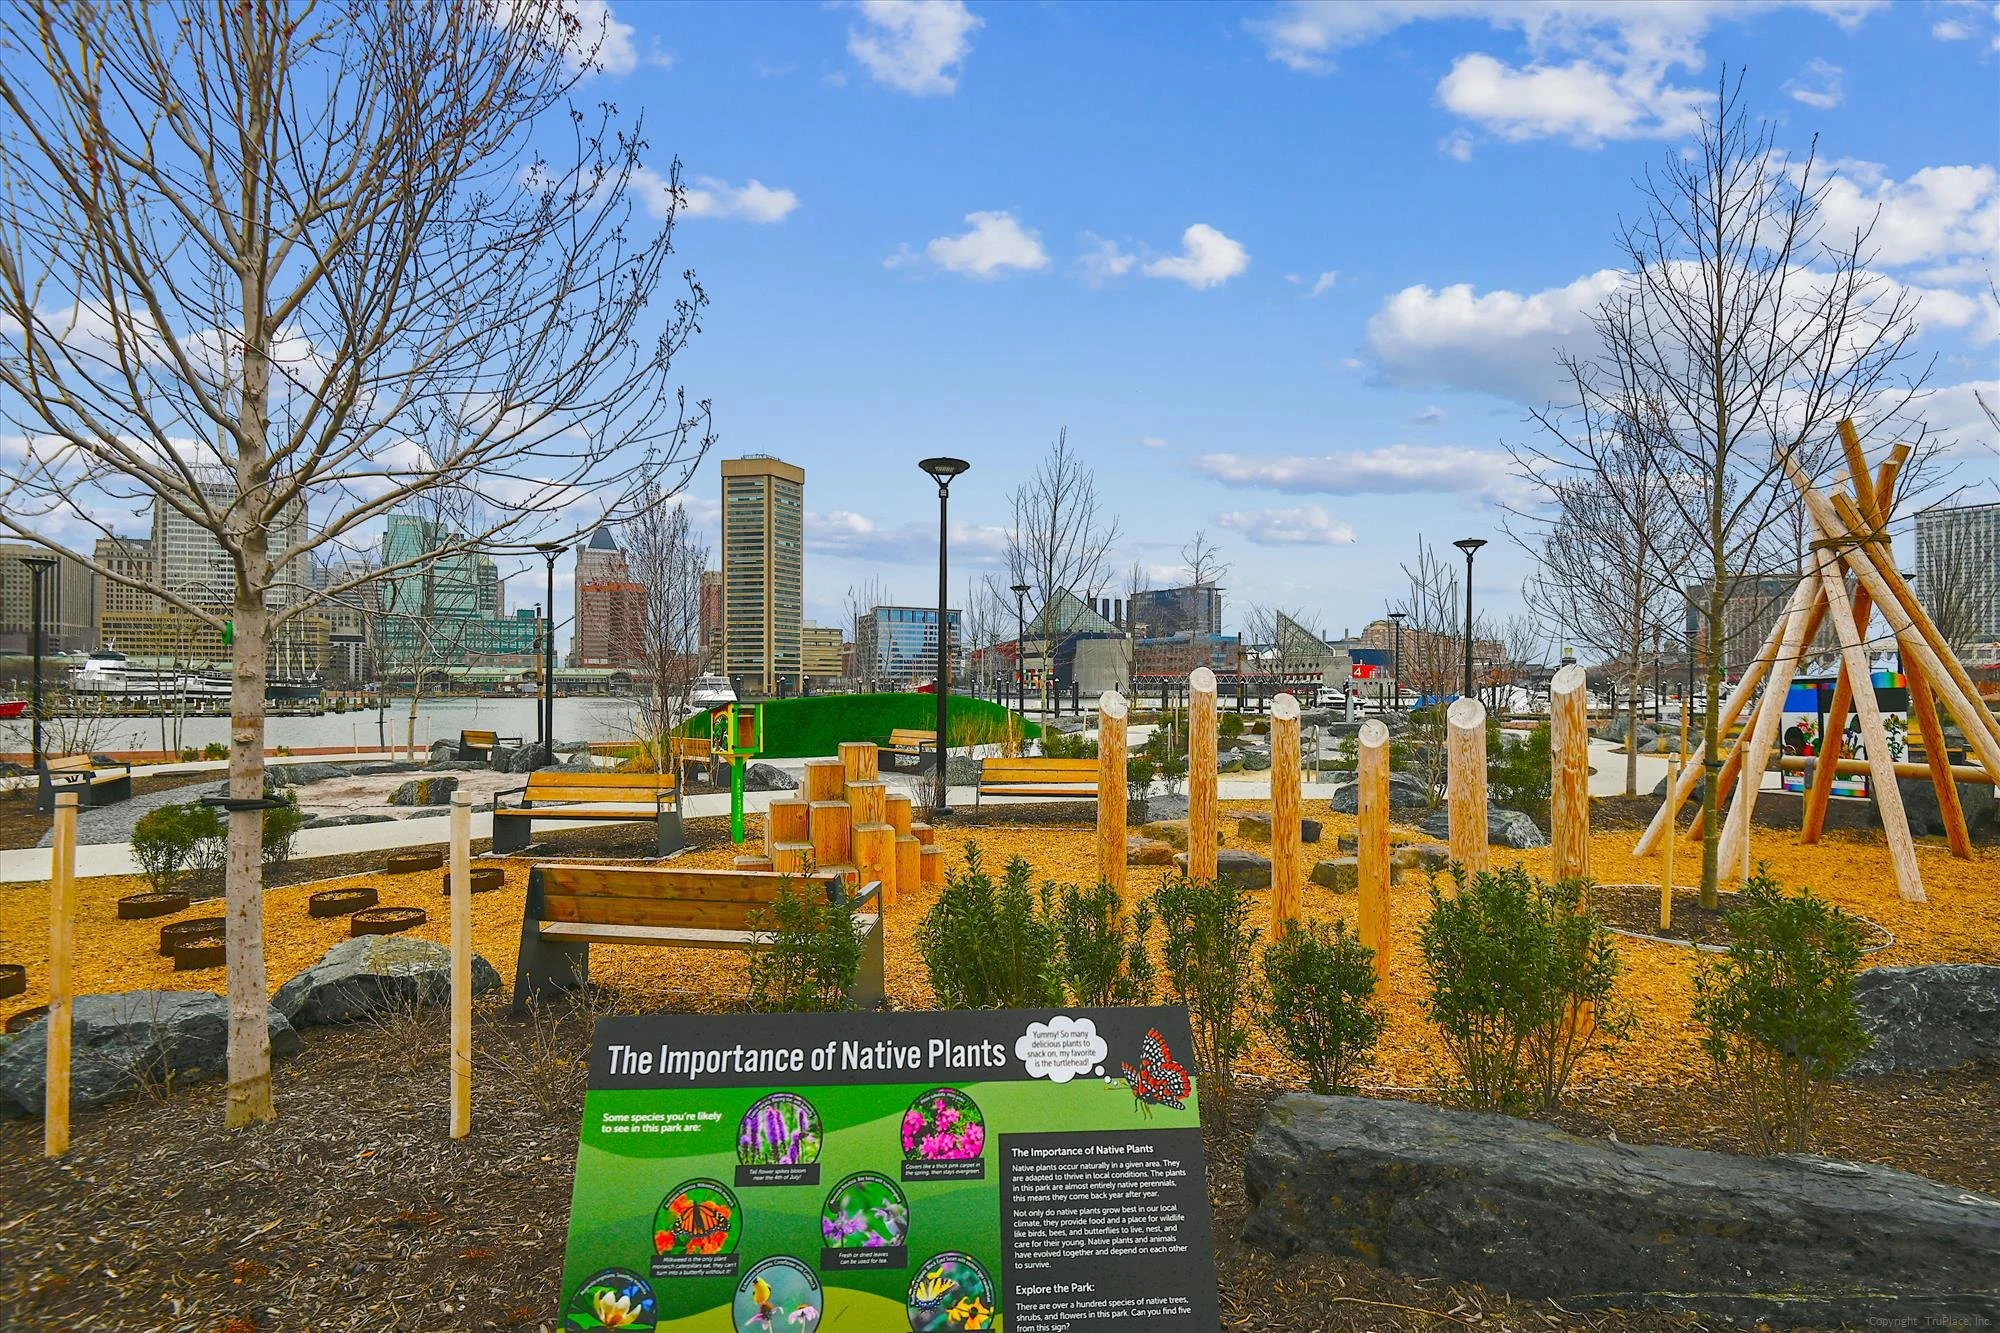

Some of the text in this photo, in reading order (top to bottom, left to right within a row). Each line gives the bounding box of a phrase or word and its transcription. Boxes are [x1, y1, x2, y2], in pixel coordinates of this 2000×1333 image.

[1033, 1030, 1088, 1041] Yummy! So many
[1032, 1039, 1061, 1048] delicious
[1062, 1040, 1082, 1049] plants
[608, 1038, 1006, 1080] The Importance of Native Plants
[1027, 1050, 1045, 1058] snack
[1060, 1051, 1070, 1059] my
[1071, 1049, 1096, 1057] favorite
[1035, 1059, 1040, 1067] is
[1054, 1058, 1089, 1067] turtlehead!
[603, 1112, 722, 1123] Some species you're likely
[602, 1125, 612, 1133] to
[631, 1124, 640, 1132] in
[642, 1124, 659, 1132] this
[661, 1123, 682, 1134] park
[1011, 1144, 1154, 1158] The Importance of Native Plants
[1012, 1164, 1034, 1172] Native
[1036, 1164, 1057, 1172] plants
[1080, 1162, 1110, 1171] naturally
[1125, 1161, 1144, 1170] given
[1163, 1159, 1180, 1168] They
[1025, 1174, 1053, 1183] adapted
[1111, 1170, 1149, 1178] conditions.
[1165, 1169, 1186, 1178] plants
[1021, 1184, 1034, 1192] this
[1035, 1184, 1051, 1192] park
[1065, 1182, 1088, 1190] almost
[1090, 1181, 1116, 1191] entirely
[1140, 1179, 1177, 1189] perennials,
[1052, 1193, 1068, 1202] they
[1125, 1190, 1141, 1198] after
[1143, 1191, 1159, 1199] year.
[1028, 1209, 1044, 1218] only
[1057, 1208, 1078, 1216] native
[1079, 1207, 1101, 1216] plants
[1102, 1208, 1120, 1216] grow
[1160, 1204, 1177, 1212] local
[1014, 1220, 1042, 1228] climate,
[1043, 1219, 1059, 1228] they
[1060, 1218, 1087, 1227] provide
[1089, 1217, 1105, 1225] food
[1107, 1216, 1120, 1224] and
[1128, 1216, 1146, 1224] place
[1160, 1214, 1185, 1222] wildlife
[1014, 1230, 1026, 1238] like
[1028, 1230, 1047, 1238] birds,
[1049, 1229, 1067, 1237] bees,
[1069, 1228, 1082, 1236] and
[1084, 1226, 1120, 1235] butterflies
[1130, 1226, 1144, 1234] live,
[1164, 1224, 1177, 1232] and
[1044, 1239, 1060, 1247] their
[1062, 1240, 1086, 1248] young.
[1112, 1236, 1133, 1246] plants
[1150, 1235, 1176, 1243] animals
[1015, 1251, 1032, 1259] have
[1033, 1250, 1061, 1258] evolved
[1063, 1248, 1094, 1258] together
[1110, 1247, 1137, 1256] depend
[1168, 1244, 1188, 1252] other
[1016, 1282, 1095, 1296] Explore the Park:
[1016, 1302, 1037, 1311] There
[1076, 1299, 1107, 1308] hundred
[1108, 1298, 1135, 1308] species
[1146, 1297, 1167, 1305] native
[1169, 1296, 1188, 1304] trees,
[1016, 1313, 1042, 1322] shrubs,
[1060, 1311, 1087, 1320] flowers
[1097, 1310, 1110, 1318] this
[1112, 1309, 1129, 1319] park.
[1131, 1308, 1146, 1316] Can
[1147, 1309, 1161, 1317] you
[1163, 1307, 1177, 1315] find
[1178, 1306, 1191, 1314] five
[1017, 1323, 1070, 1333] from this sign?
